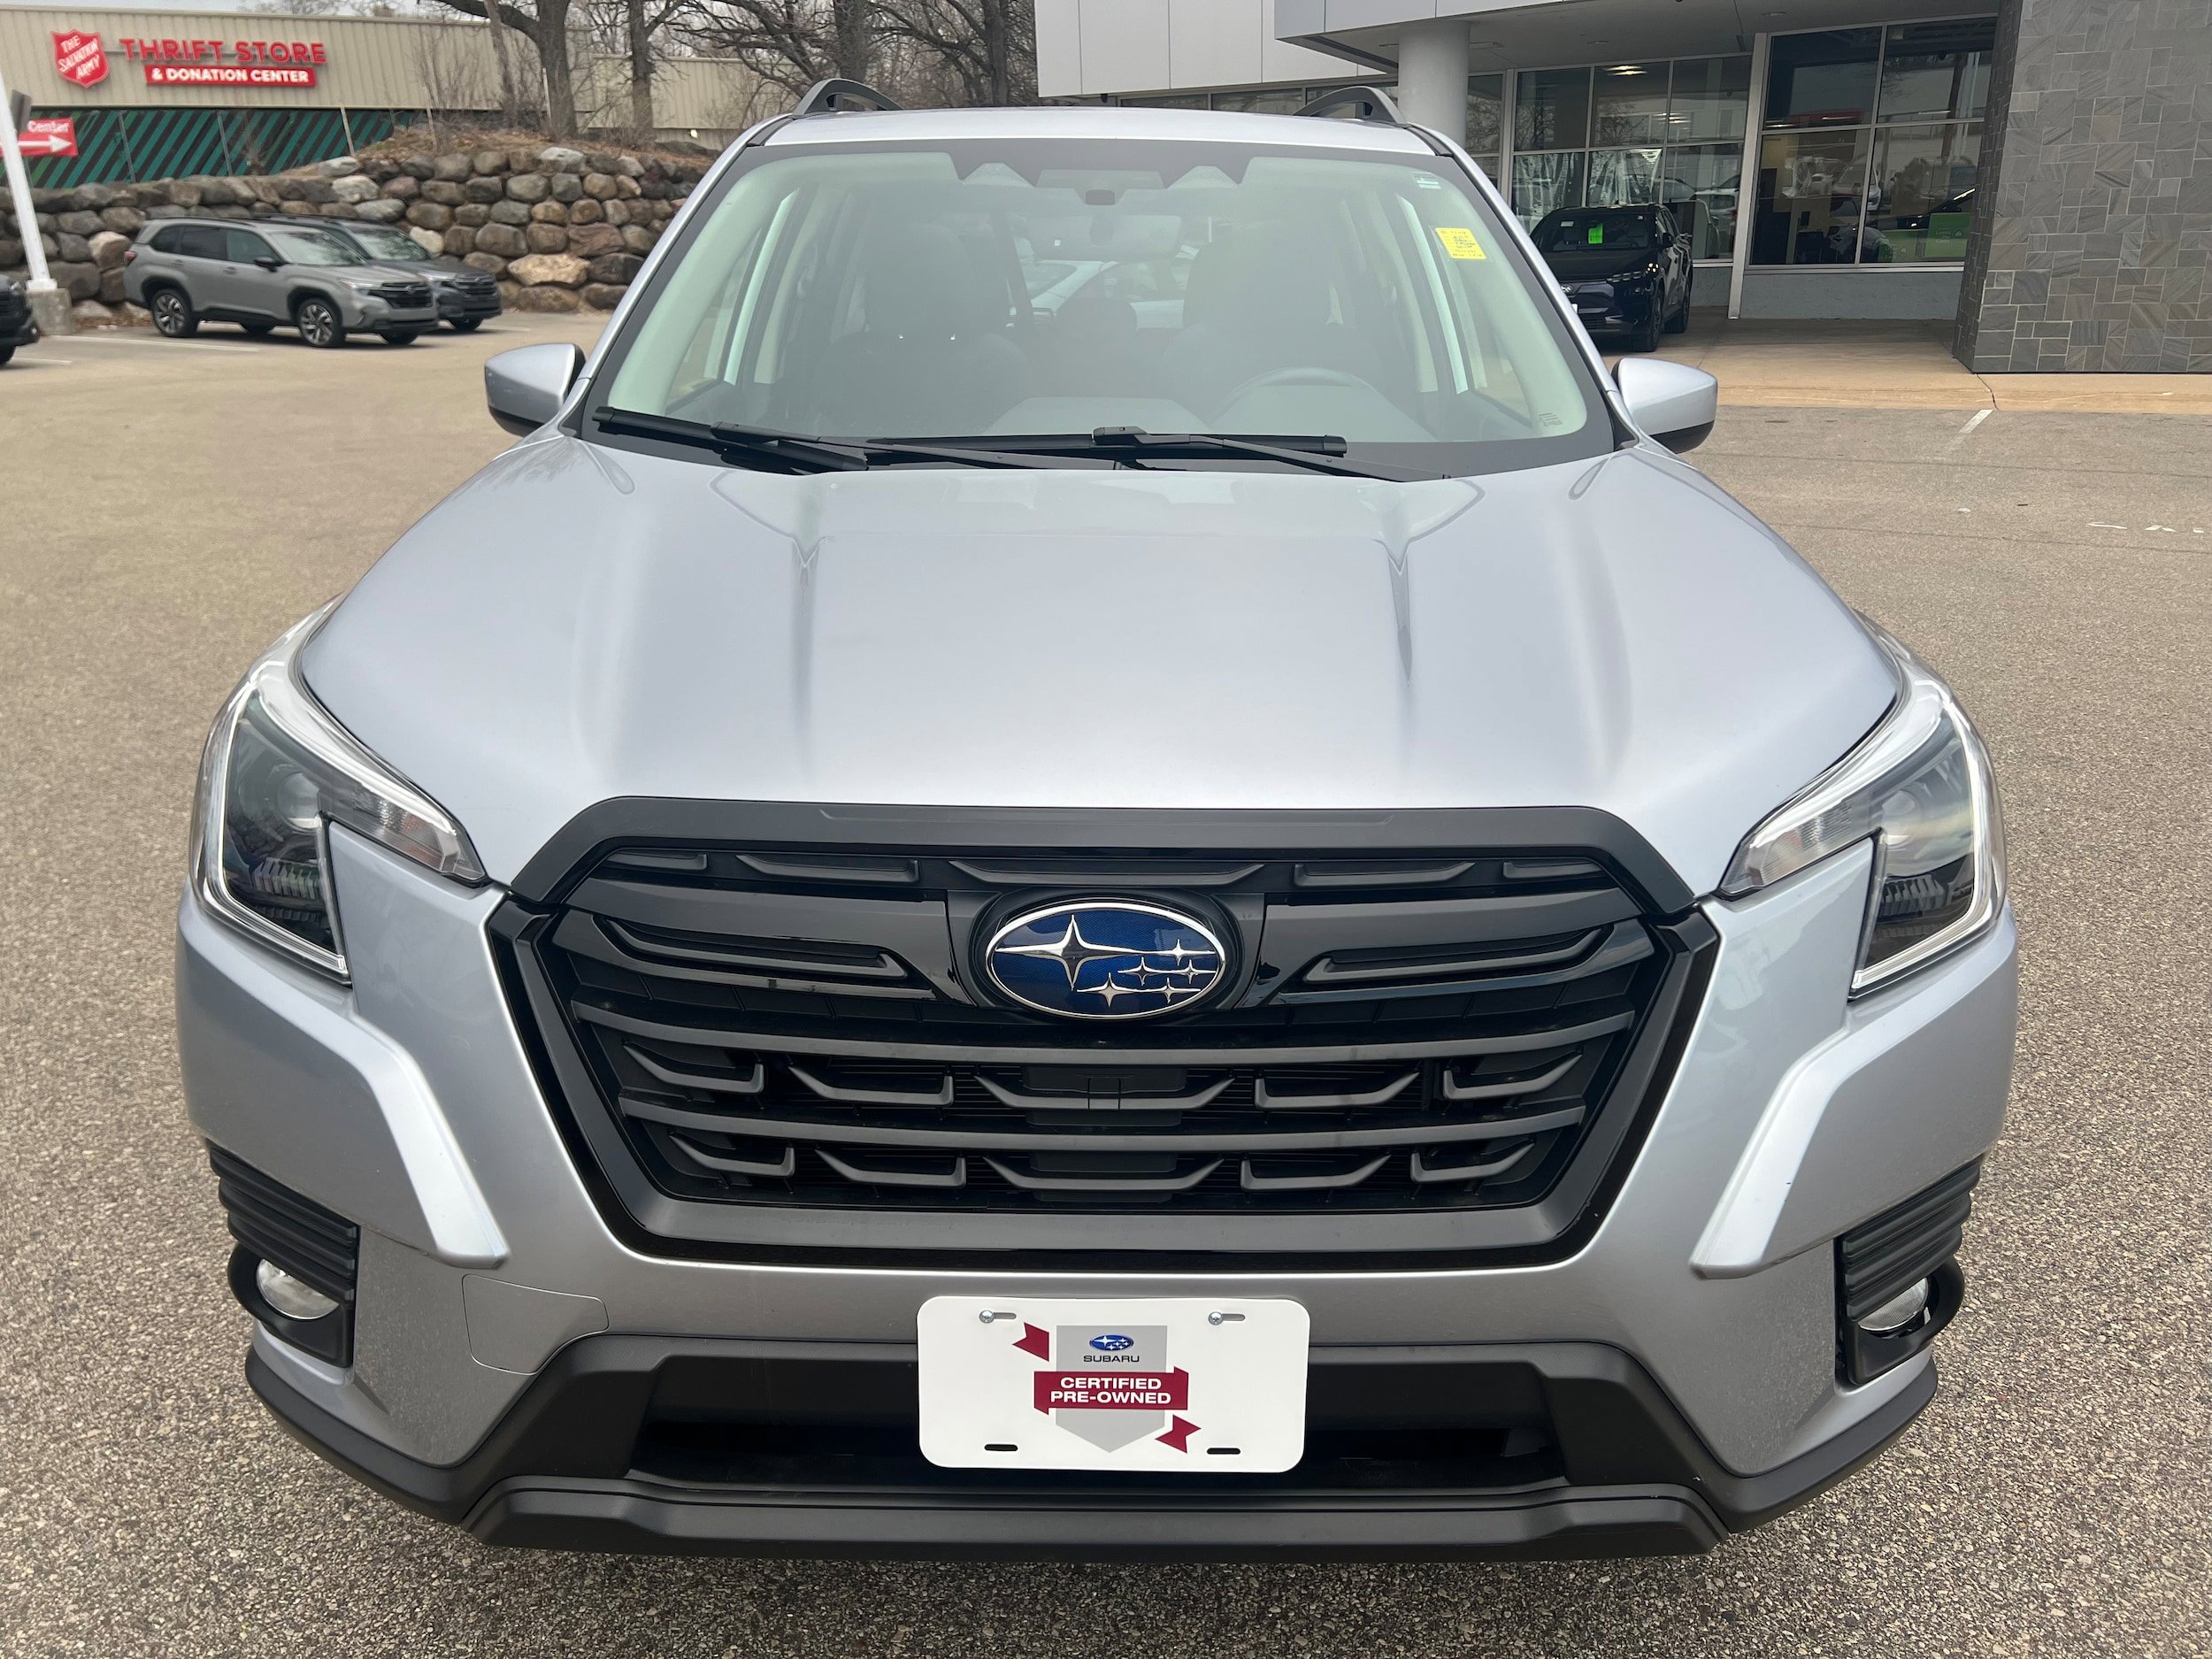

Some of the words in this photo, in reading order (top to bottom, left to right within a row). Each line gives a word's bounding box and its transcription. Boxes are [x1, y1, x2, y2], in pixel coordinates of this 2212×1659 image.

[61, 35, 81, 54] THE
[119, 39, 224, 61] THRIFT
[234, 42, 326, 64] STORE
[58, 38, 99, 73] SALVATION
[75, 54, 100, 80] ARMY
[151, 67, 164, 81] &
[165, 67, 248, 82] DONATION
[250, 69, 309, 83] CENTER
[27, 120, 69, 134] Center
[1060, 1377, 1162, 1390] CERTIFIED
[1050, 1390, 1171, 1404] PRE-OWNED
